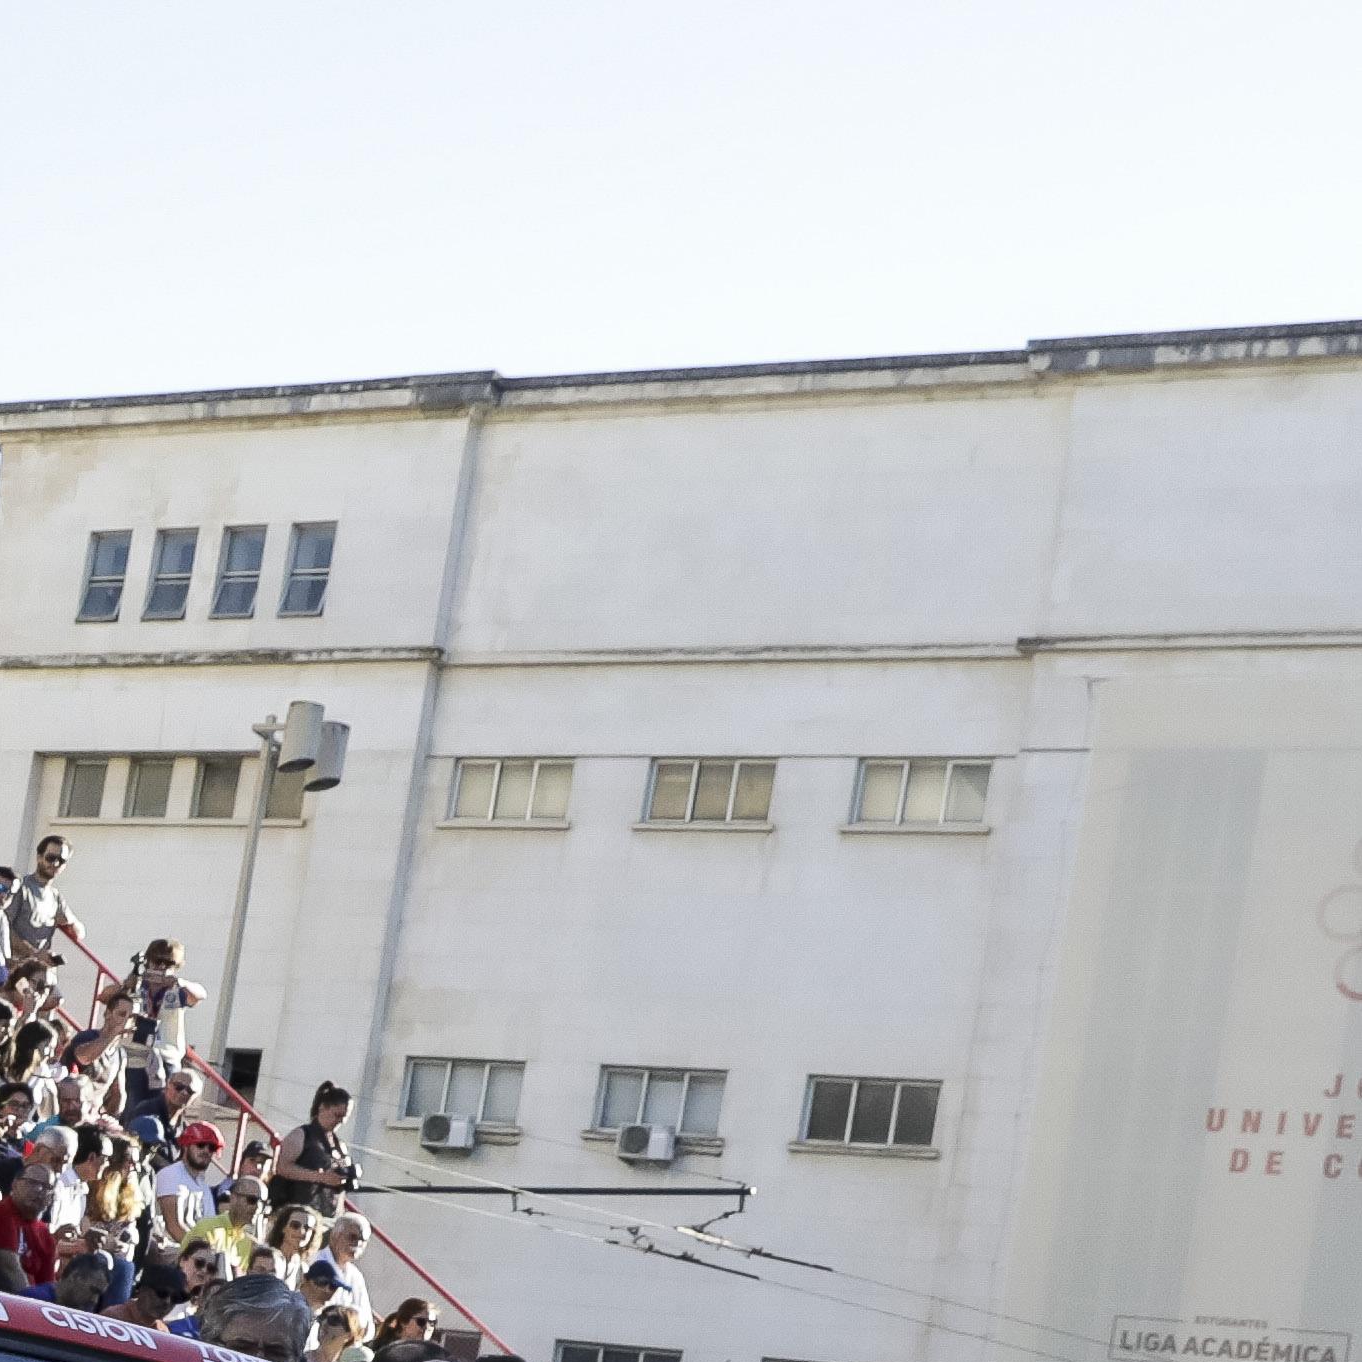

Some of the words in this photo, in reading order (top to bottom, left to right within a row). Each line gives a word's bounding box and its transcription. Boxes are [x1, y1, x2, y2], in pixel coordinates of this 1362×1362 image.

[1205, 1106, 1356, 1139] UNIVE
[1229, 1147, 1284, 1175] DE
[39, 1305, 158, 1351] CISION
[1119, 1329, 1177, 1355] LIGA
